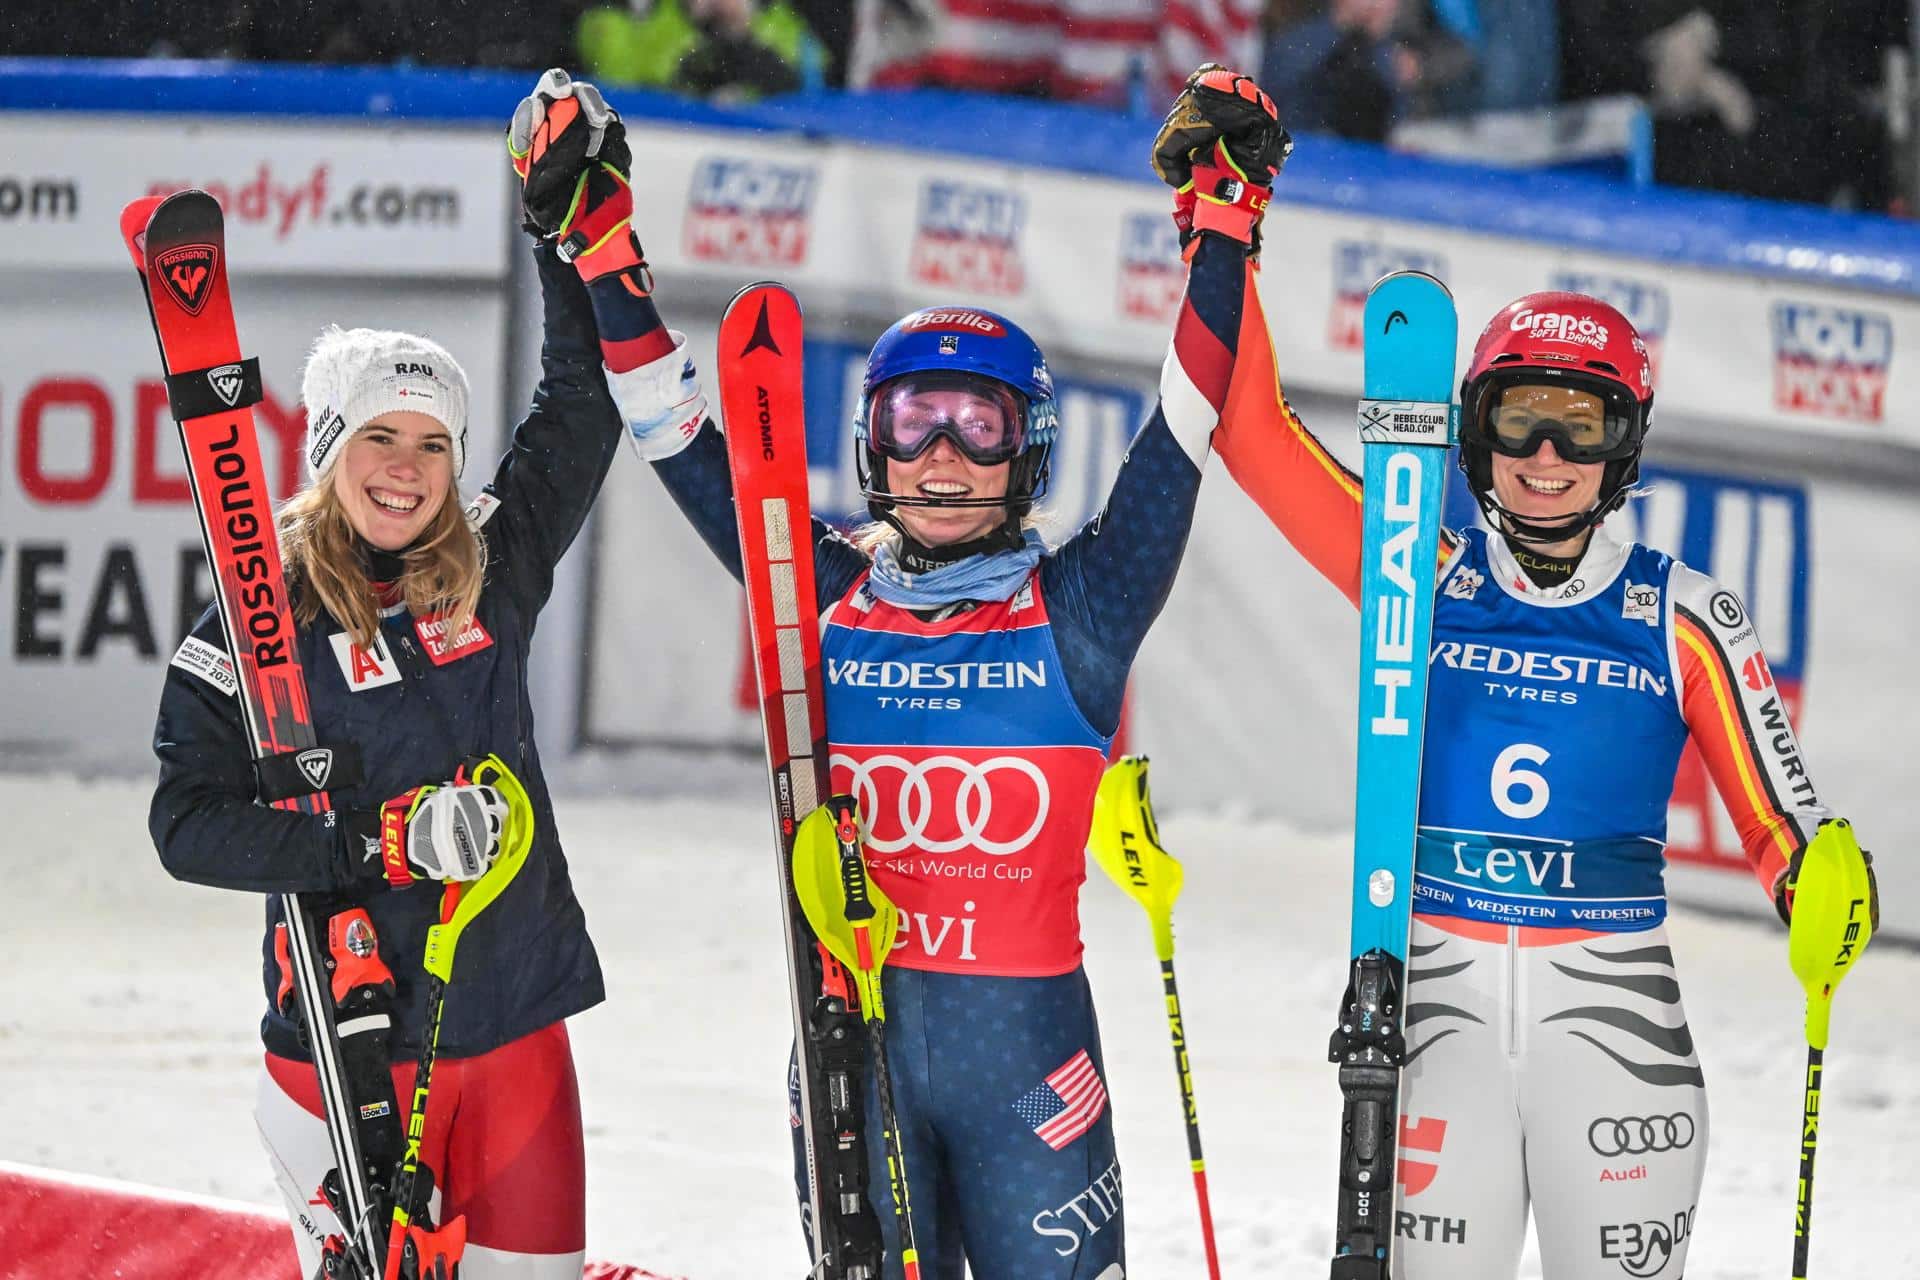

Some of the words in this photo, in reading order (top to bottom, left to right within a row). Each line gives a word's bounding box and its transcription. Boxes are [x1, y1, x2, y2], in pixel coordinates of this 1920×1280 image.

[0, 177, 78, 220] om
[164, 251, 209, 266] ROSSIGNOL
[911, 312, 998, 332] Barilla
[1529, 328, 1556, 339] SOFT
[1566, 334, 1606, 351] DRINKS
[312, 416, 343, 465] GIESSWEIN
[756, 385, 775, 462] ATOMIC
[1394, 423, 1435, 434] HEAD.COM
[209, 424, 288, 669] ROSSIGNOL
[1371, 452, 1423, 736] HEAD
[194, 646, 217, 662] ALPINE
[208, 667, 235, 688] 2025
[828, 658, 1046, 689] VREDESTEIN
[877, 696, 962, 710] TYRES
[1484, 682, 1578, 705] TYRES
[779, 772, 791, 818] REDSTER
[1490, 743, 1551, 820] 6
[385, 813, 402, 867] LEKI
[1101, 831, 1148, 887] LEKI
[920, 859, 987, 879] World
[993, 863, 1033, 885] Cup
[1453, 840, 1576, 888] Levi
[1466, 896, 1557, 919] VREDESTEIN
[1571, 908, 1656, 921] VREDESTEIN
[890, 900, 977, 961] evi
[1834, 899, 1863, 966] LEKI
[362, 1109, 382, 1119] LOOK
[1803, 1065, 1823, 1147] LEKI
[403, 1087, 429, 1173] LEKI
[1600, 1165, 1647, 1182] Audi
[1395, 1210, 1466, 1244] RTH
